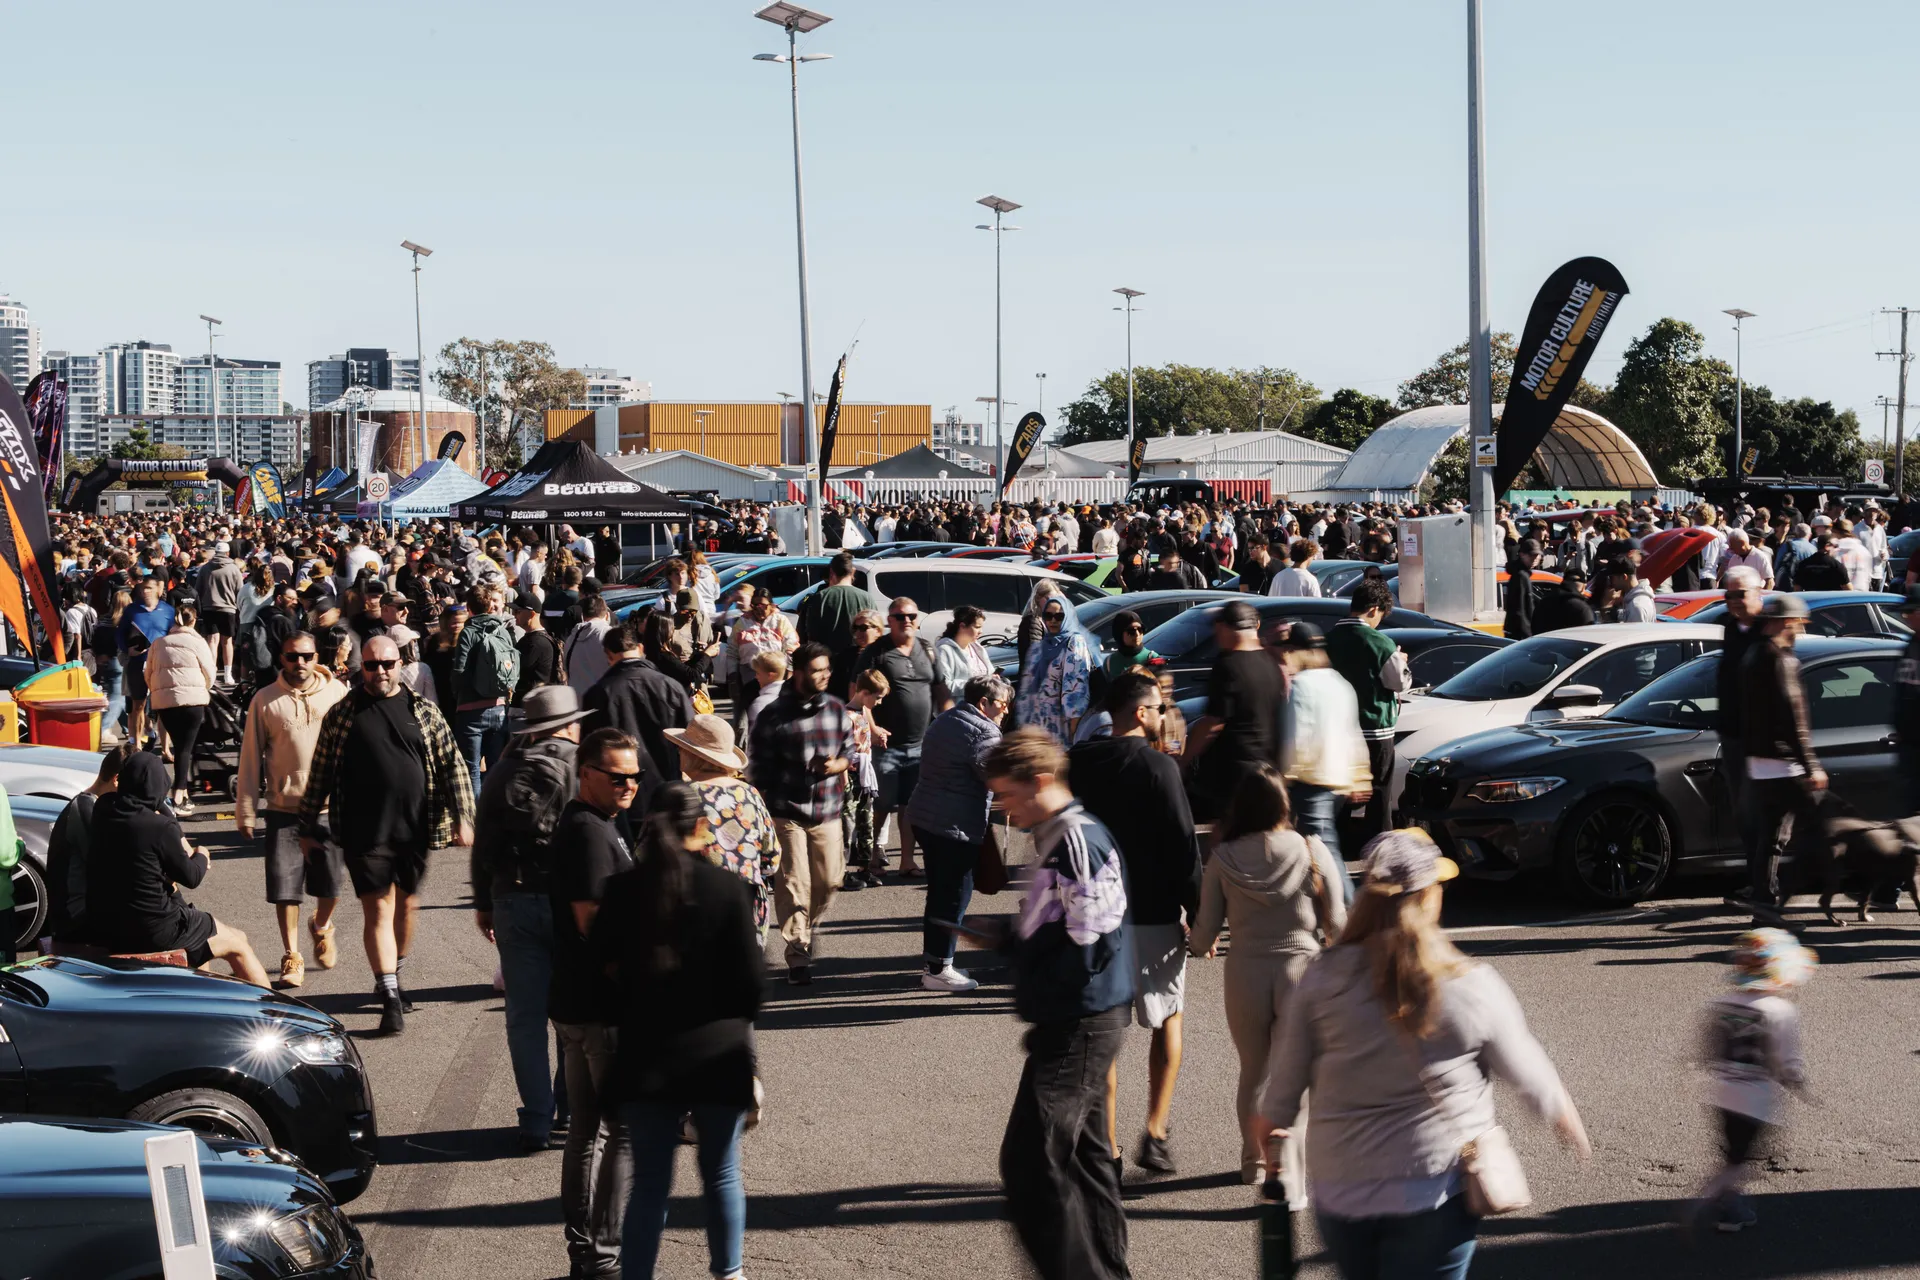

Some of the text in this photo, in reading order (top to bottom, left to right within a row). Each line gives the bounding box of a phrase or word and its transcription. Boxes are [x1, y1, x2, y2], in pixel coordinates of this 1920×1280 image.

[1585, 291, 1619, 340] AUSTRALIA
[1519, 278, 1595, 392] MOTOR CULTURE
[1015, 417, 1039, 459] CARS
[122, 458, 208, 473] MOTOR CULTURE
[1742, 447, 1757, 475] CARS
[1868, 468, 1880, 477] 20
[173, 480, 208, 488] AUSTRALIA
[371, 483, 385, 493] 20
[405, 505, 449, 514] MERAKI
